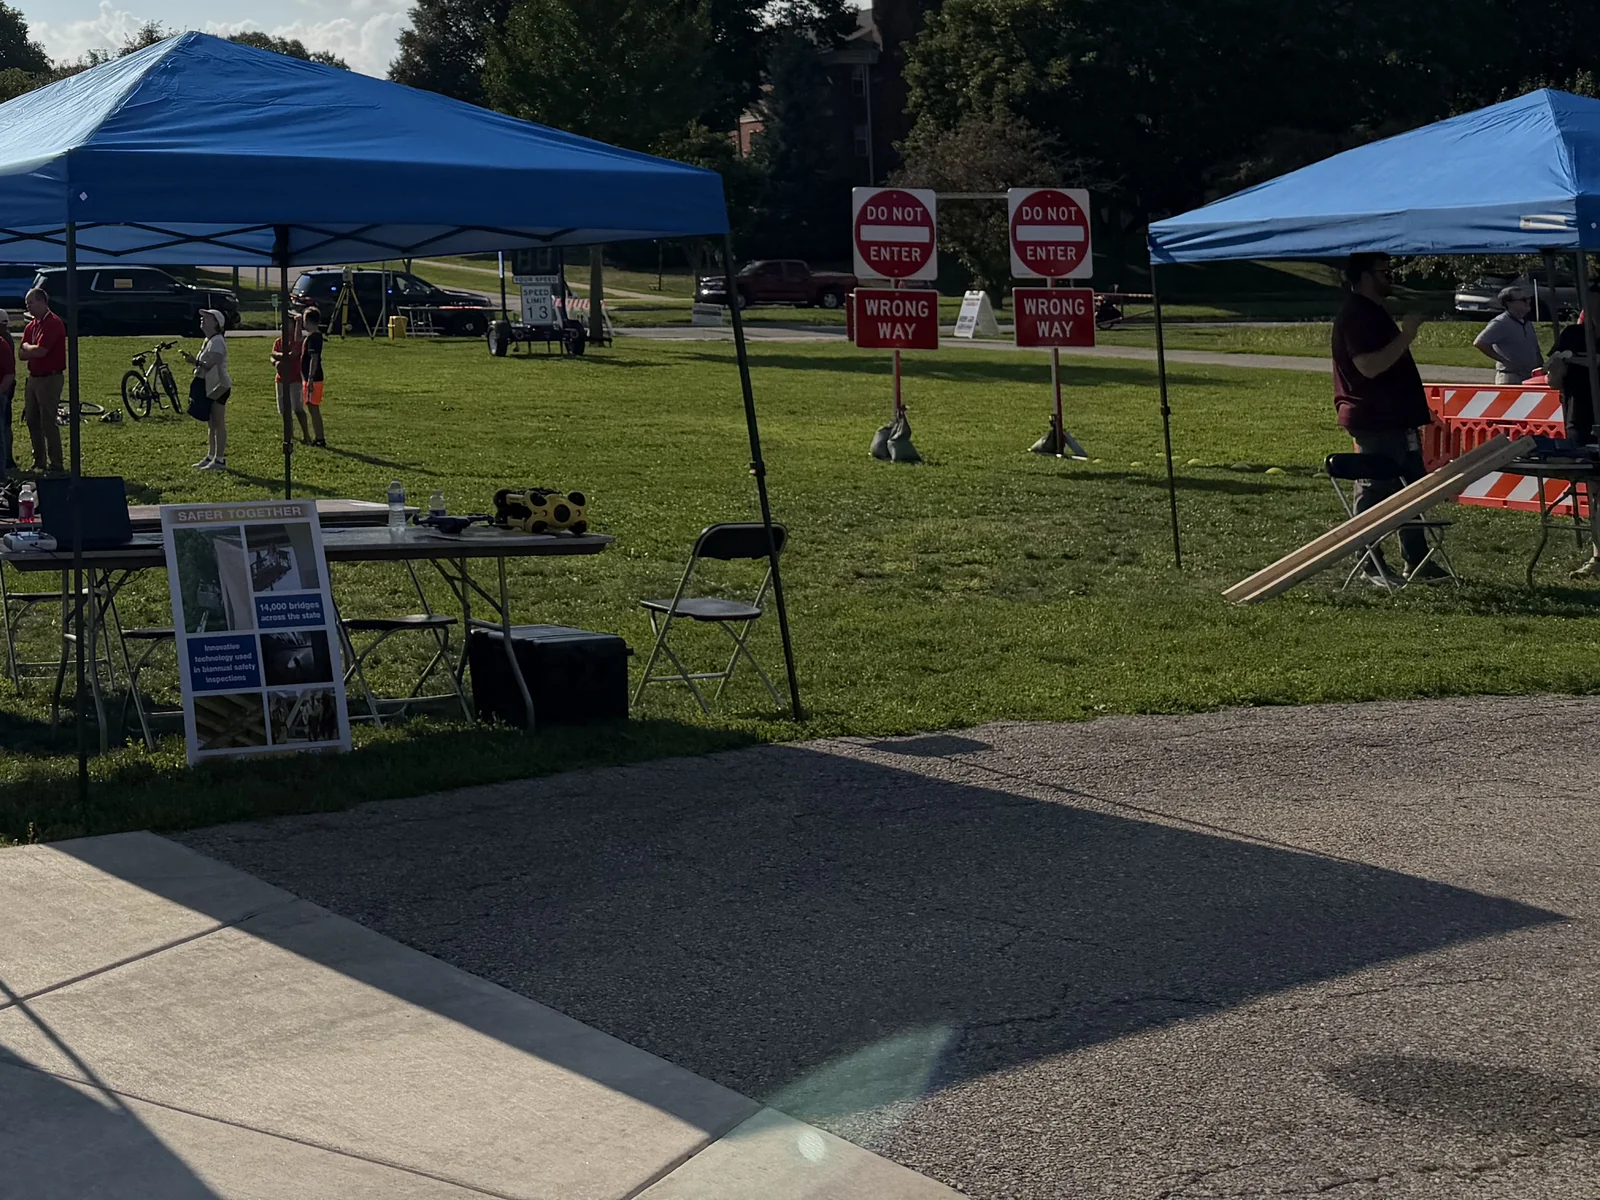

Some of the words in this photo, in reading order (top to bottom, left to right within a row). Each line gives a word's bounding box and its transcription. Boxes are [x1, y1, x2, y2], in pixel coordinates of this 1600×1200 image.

[867, 205, 888, 221] DO
[893, 206, 923, 221] NOT
[1022, 205, 1043, 221] DO
[1047, 206, 1077, 221] NOT
[870, 246, 921, 262] ENTER
[1026, 246, 1076, 261] ENTER
[865, 299, 929, 317] WRONG
[1023, 298, 1086, 316] WRONG
[878, 322, 917, 340] WAY
[1037, 320, 1074, 338] WAY
[178, 509, 223, 522] SAFER
[227, 506, 302, 519] TOGETHER
[260, 602, 287, 612] 14,000
[288, 601, 320, 611] bridges
[261, 614, 286, 622] across
[287, 612, 301, 621] the
[302, 611, 322, 620] state
[194, 654, 233, 663] technology
[234, 652, 253, 661] used
[233, 662, 257, 672] safety
[205, 674, 247, 684] inspections
